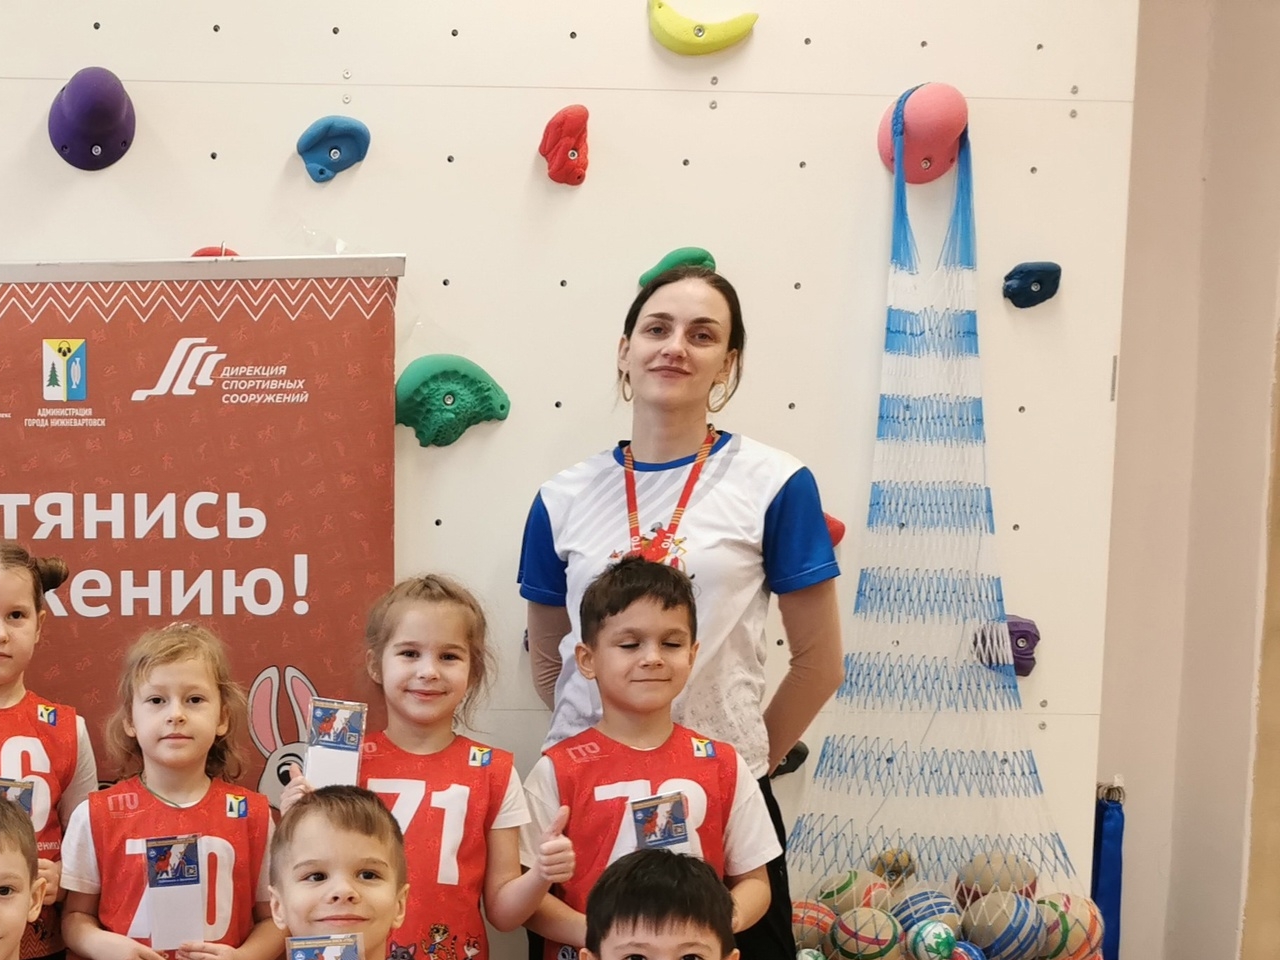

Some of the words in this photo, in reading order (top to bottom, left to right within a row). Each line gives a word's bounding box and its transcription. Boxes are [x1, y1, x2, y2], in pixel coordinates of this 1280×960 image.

[220, 365, 287, 378] ДИРЕКЦИЯ
[221, 378, 306, 391] СПОРТИВНЫХ
[221, 391, 309, 404] СООРУЖЕНИЙ
[37, 407, 93, 417] АДМИНИСТРАЦИЯ
[24, 418, 49, 427] ГОРОДА
[50, 418, 106, 427] НИЖНЕВАРТОВСК
[107, 792, 139, 813] ГТО
[367, 778, 470, 886] 71
